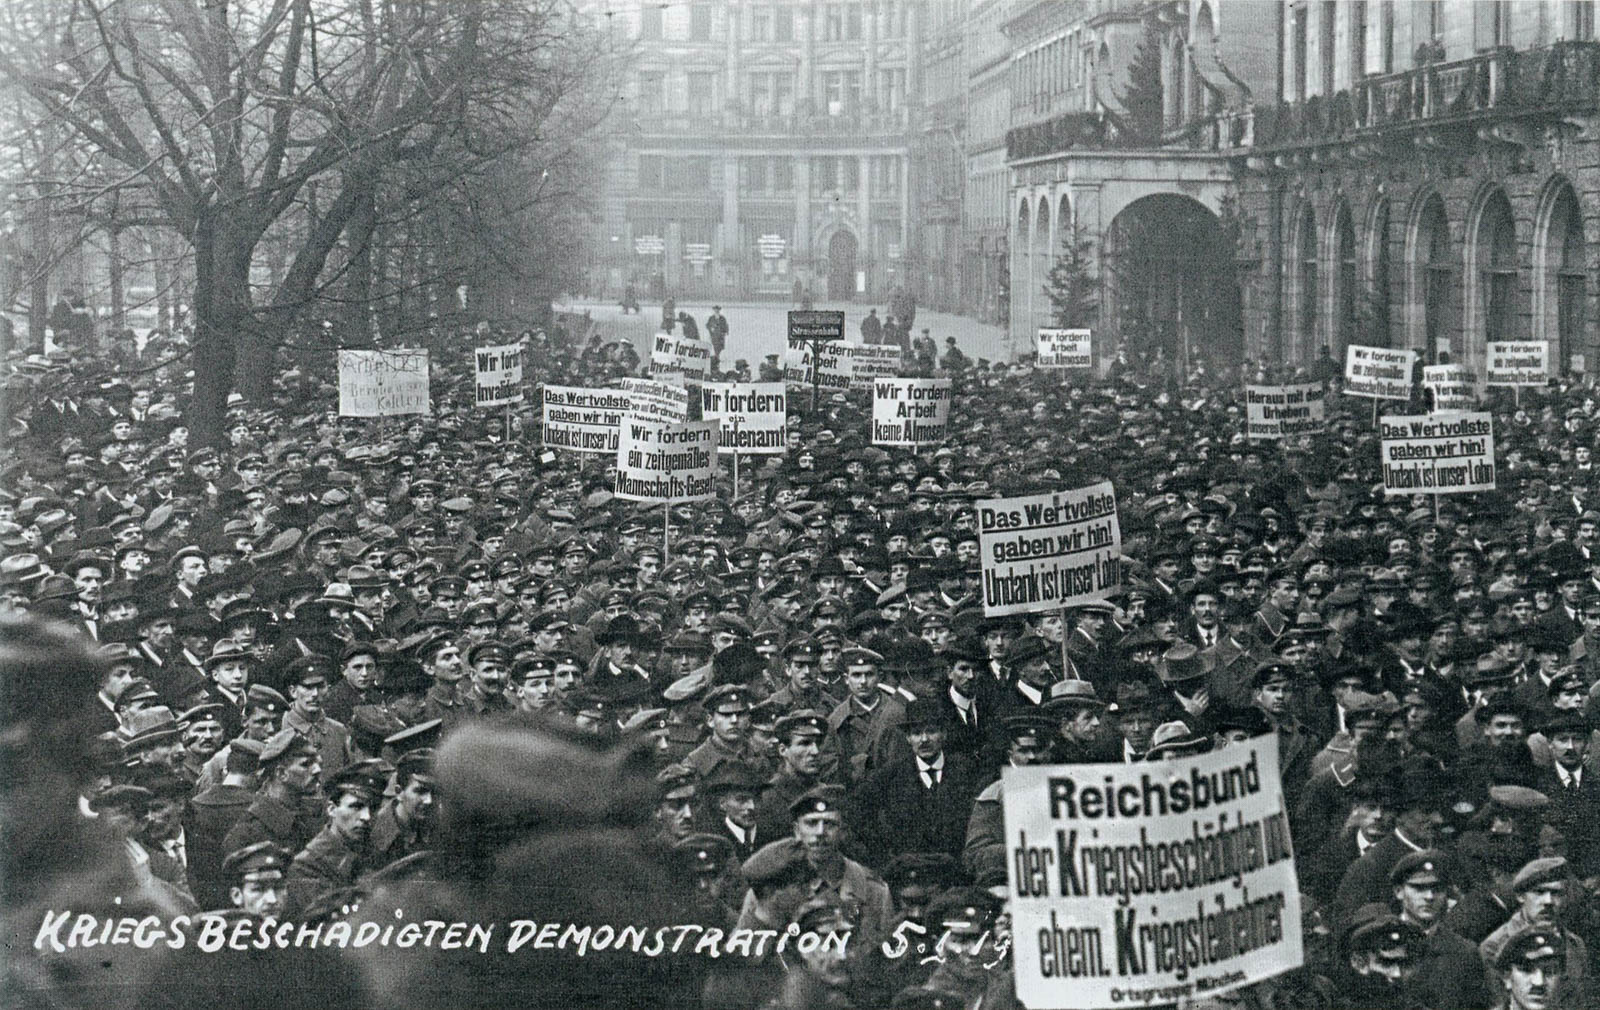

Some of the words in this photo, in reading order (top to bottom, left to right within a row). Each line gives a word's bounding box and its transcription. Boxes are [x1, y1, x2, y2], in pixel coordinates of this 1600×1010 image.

[1040, 333, 1053, 342] Wir
[1056, 332, 1090, 342] fordern
[1050, 343, 1077, 352] Arbeit
[655, 337, 673, 354] Wir
[674, 341, 710, 360] fordern
[788, 340, 806, 351] Wir
[818, 343, 854, 358] ordern
[1355, 349, 1369, 360] Wir
[1372, 351, 1406, 363] fordern
[1495, 345, 1507, 353] Wir
[1510, 344, 1542, 353] fordern
[477, 352, 498, 372] Wir
[545, 390, 564, 403] Das
[566, 391, 630, 408] Wertvollste
[703, 388, 721, 412] Wir
[725, 389, 784, 413] fordern
[875, 383, 902, 400] Wir
[907, 384, 952, 400] fordern
[1248, 390, 1285, 404] Heraus
[1287, 389, 1303, 404] mit
[549, 408, 580, 421] gaben
[583, 410, 602, 423] wir
[650, 404, 685, 422] Ordnung
[729, 414, 746, 423] ein
[896, 401, 937, 418] Arbeit
[544, 423, 571, 446] Undank
[571, 425, 581, 448] ist
[582, 431, 608, 450] unser
[608, 429, 620, 450] Lo
[631, 424, 652, 443] Wir
[657, 428, 711, 444] fordern
[717, 424, 785, 447] alidenamt
[874, 419, 902, 441] keine
[1382, 423, 1408, 437] Das
[1410, 419, 1490, 437] Wertvollste
[628, 445, 642, 468] ein
[1389, 442, 1432, 460] gaben
[1434, 441, 1457, 456] wir
[1460, 438, 1486, 454] hin!
[1384, 462, 1422, 489] Undank
[1422, 462, 1437, 487] ist
[1437, 466, 1468, 487] unser
[1468, 458, 1494, 485] Lohn
[981, 508, 1022, 529] Das
[1024, 493, 1115, 526] Wertvollste
[993, 535, 1054, 563] gaben
[1057, 528, 1085, 551] wir
[1087, 520, 1113, 547] hin!
[985, 565, 1040, 607] Undank
[1041, 563, 1059, 601] ist
[1061, 562, 1096, 599] unser
[1096, 550, 1120, 591] Lohn
[1048, 749, 1260, 820] Reichsbund
[1015, 829, 1054, 897] der
[1056, 810, 1264, 907] Kriegsbeschädigten
[1038, 910, 1112, 979] ehem.
[1114, 886, 1286, 980] Kriegsteilnehmer
[1111, 983, 1193, 1005] Ortsgruppe
